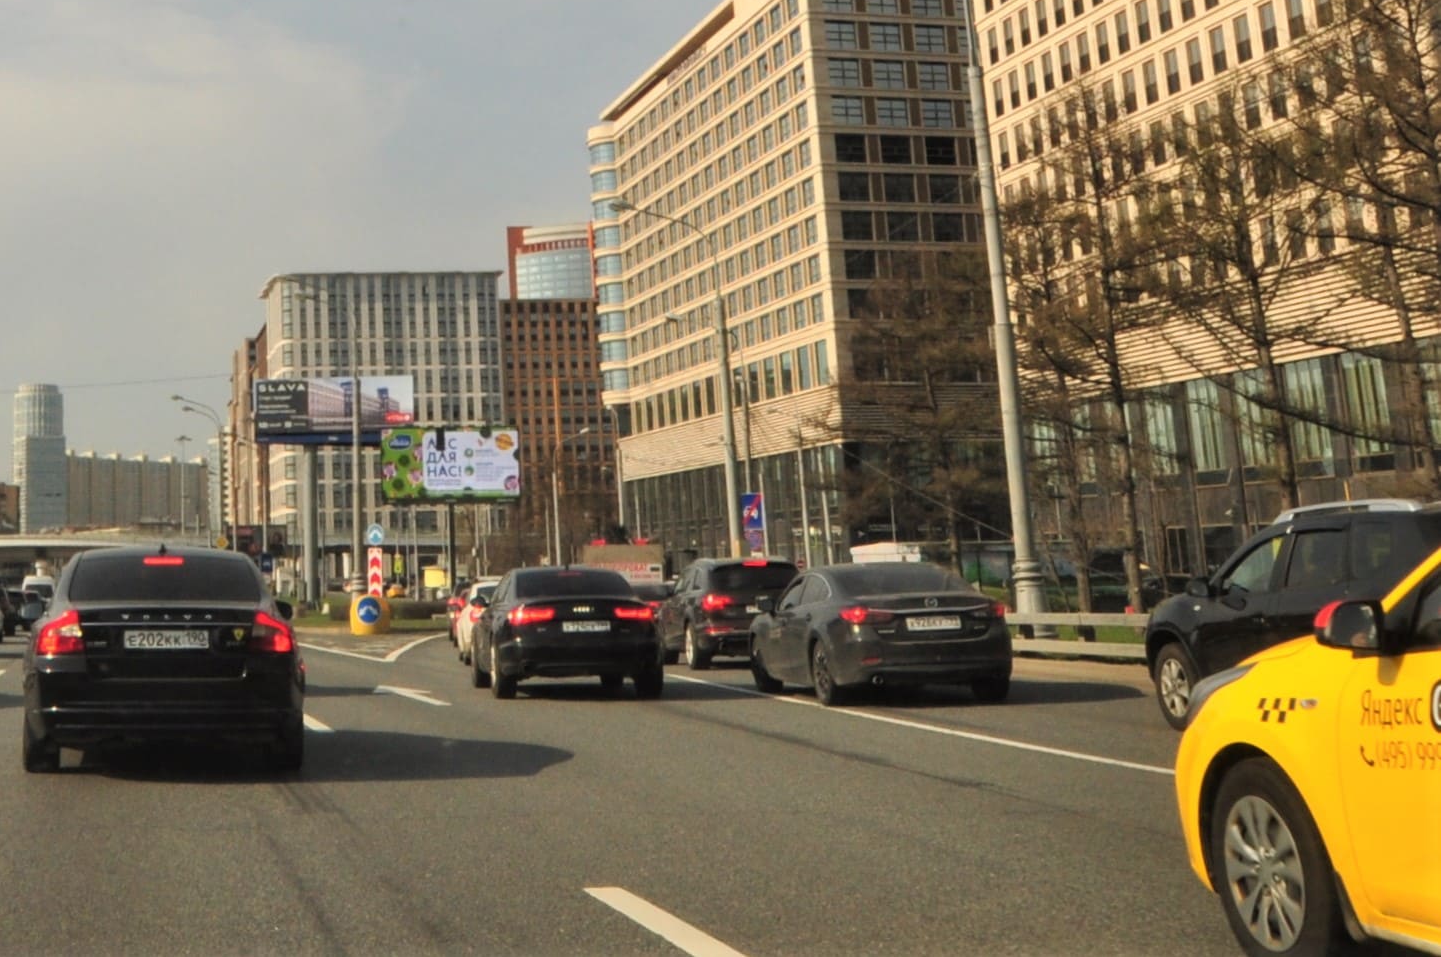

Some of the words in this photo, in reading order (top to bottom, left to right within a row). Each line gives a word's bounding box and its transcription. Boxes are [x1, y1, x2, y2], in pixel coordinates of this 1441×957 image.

[259, 383, 306, 392] SLAVA
[426, 451, 457, 464] ДЛЯ
[427, 465, 462, 477] НАС!
[1360, 689, 1423, 730] Яндекс
[1376, 741, 1414, 769] (495)
